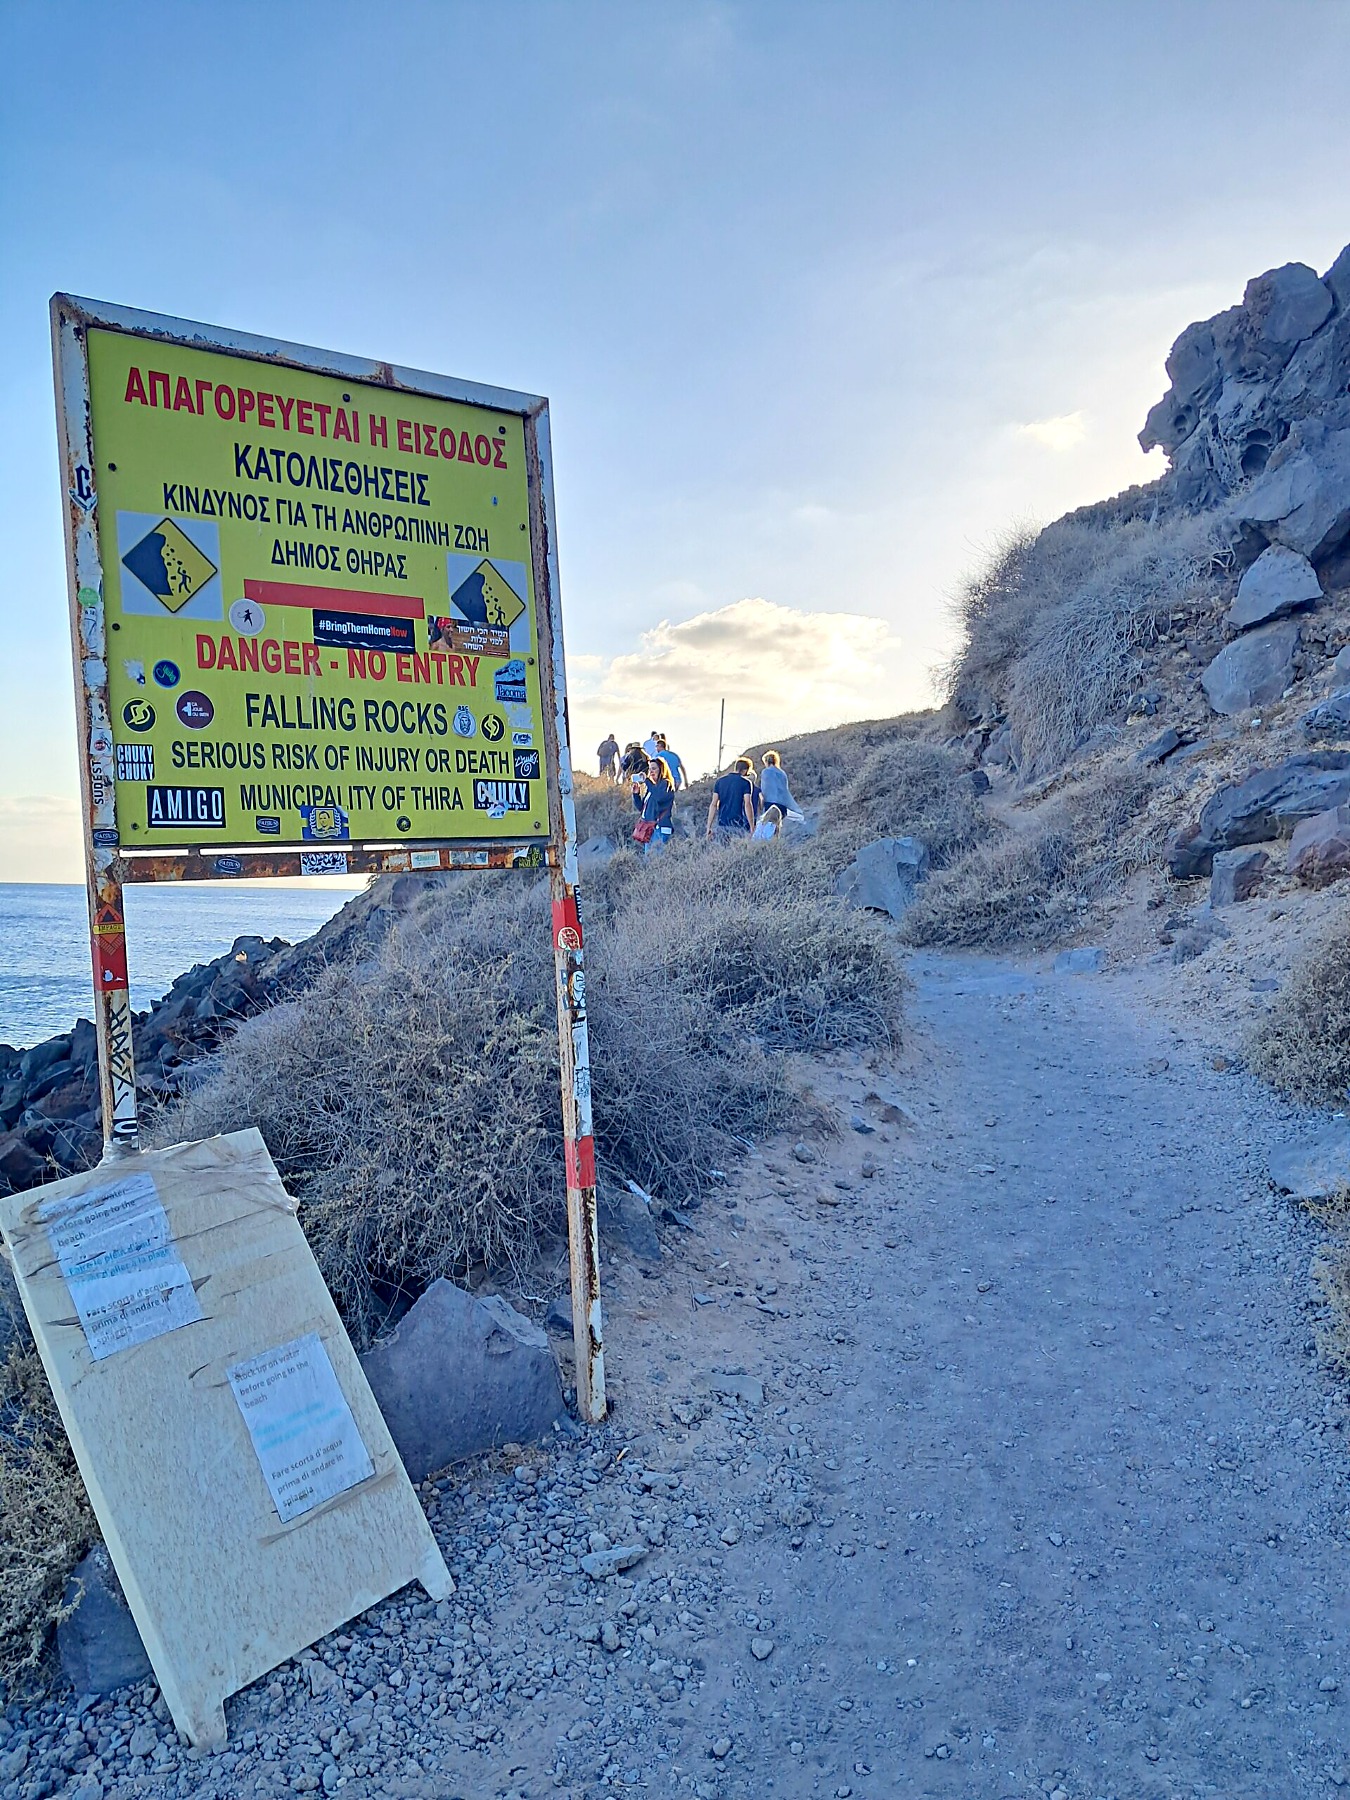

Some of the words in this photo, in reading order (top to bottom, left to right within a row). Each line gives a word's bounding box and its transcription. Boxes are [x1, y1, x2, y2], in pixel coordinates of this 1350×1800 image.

[124, 366, 360, 443] ΑΠΑΓΟΡΕΥΕΤΑΙ
[369, 413, 388, 448] Η
[397, 419, 507, 469] ΕΙΣΟΔΟΣ
[234, 442, 431, 506] ΚΑΤΟΛΙΣΘΗΣΕΙΣ
[163, 483, 270, 522] ΚΙΝΔΥΝΟΣ
[276, 498, 307, 527] ΓΙΑ
[312, 504, 337, 531] ΤΗ
[342, 508, 449, 546] ΑΝΘΡΩΠΙΝΗ
[454, 524, 489, 552] ΖΩΗ
[271, 539, 341, 571] ΔΗΜΟΣ
[346, 548, 408, 579] ΘΗΡΑΣ
[319, 619, 408, 638] #BringThemHomeNow
[196, 634, 323, 676] DANGER
[347, 649, 387, 681] NO
[395, 653, 480, 687] ENTRY
[497, 685, 526, 698] Tacoma
[245, 693, 356, 732] FALLING
[363, 699, 448, 736] ROCKS
[117, 744, 154, 763] CHUKY
[172, 740, 265, 769] SERIOUS
[272, 744, 319, 770] RISK
[324, 745, 349, 770] OF
[356, 746, 420, 772] INJURY
[425, 749, 451, 773] OR
[456, 750, 509, 774] DEATH
[92, 760, 104, 805] SUDEST
[118, 763, 154, 780] CHUKY
[151, 789, 223, 820] AMIGO
[240, 785, 376, 810] MUNICIPALITY
[382, 785, 405, 811] OF
[411, 786, 464, 810] THIRA
[477, 781, 527, 804] CHUKY
[85, 1209, 109, 1223] going
[110, 1204, 120, 1213] to
[120, 1198, 136, 1209] the
[58, 1232, 85, 1246] beach
[91, 1315, 118, 1332] prima
[130, 1299, 159, 1314] andare
[267, 1359, 279, 1368] on
[279, 1350, 300, 1362] water
[240, 1381, 265, 1395] before
[265, 1371, 287, 1385] going
[287, 1366, 296, 1375] to
[295, 1359, 310, 1370] the
[245, 1393, 267, 1408] beach
[272, 1467, 290, 1479] Fare
[290, 1455, 315, 1470] scorta
[314, 1440, 344, 1457] d'acqua
[277, 1478, 301, 1493] prima
[300, 1471, 310, 1481] di
[310, 1460, 336, 1475] andare
[335, 1453, 345, 1462] in
[282, 1486, 315, 1507] spiaggia
